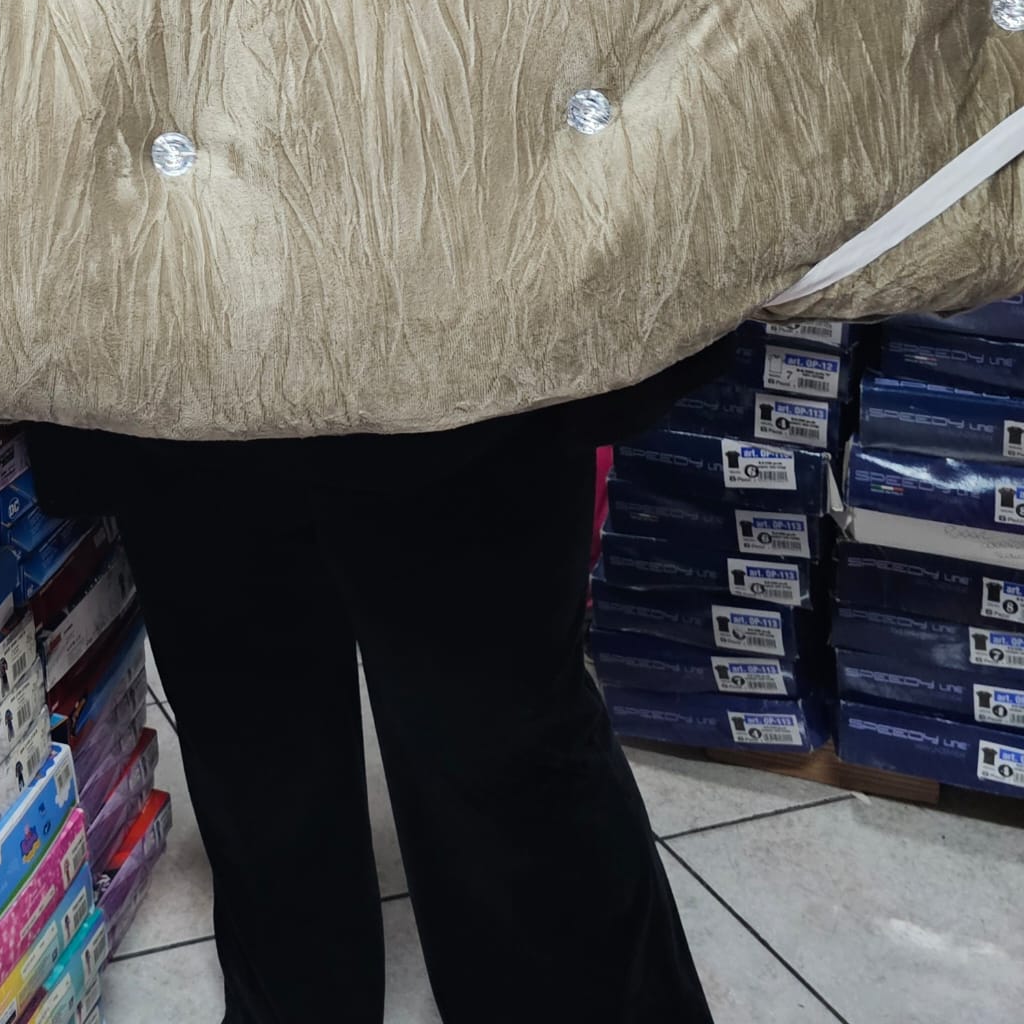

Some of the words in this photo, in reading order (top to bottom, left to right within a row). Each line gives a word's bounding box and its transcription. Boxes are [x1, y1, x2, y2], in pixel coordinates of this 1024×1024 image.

[787, 357, 804, 368] art.
[888, 342, 984, 364] SPEEDY
[786, 370, 793, 380] 7
[868, 408, 964, 429] SPEEDY
[620, 446, 703, 467] SPEEDY
[847, 557, 939, 581] SPEEDY
[1006, 584, 1022, 595] art.
[844, 666, 935, 690] SPEEDY
[849, 718, 940, 746] SPEEDY
